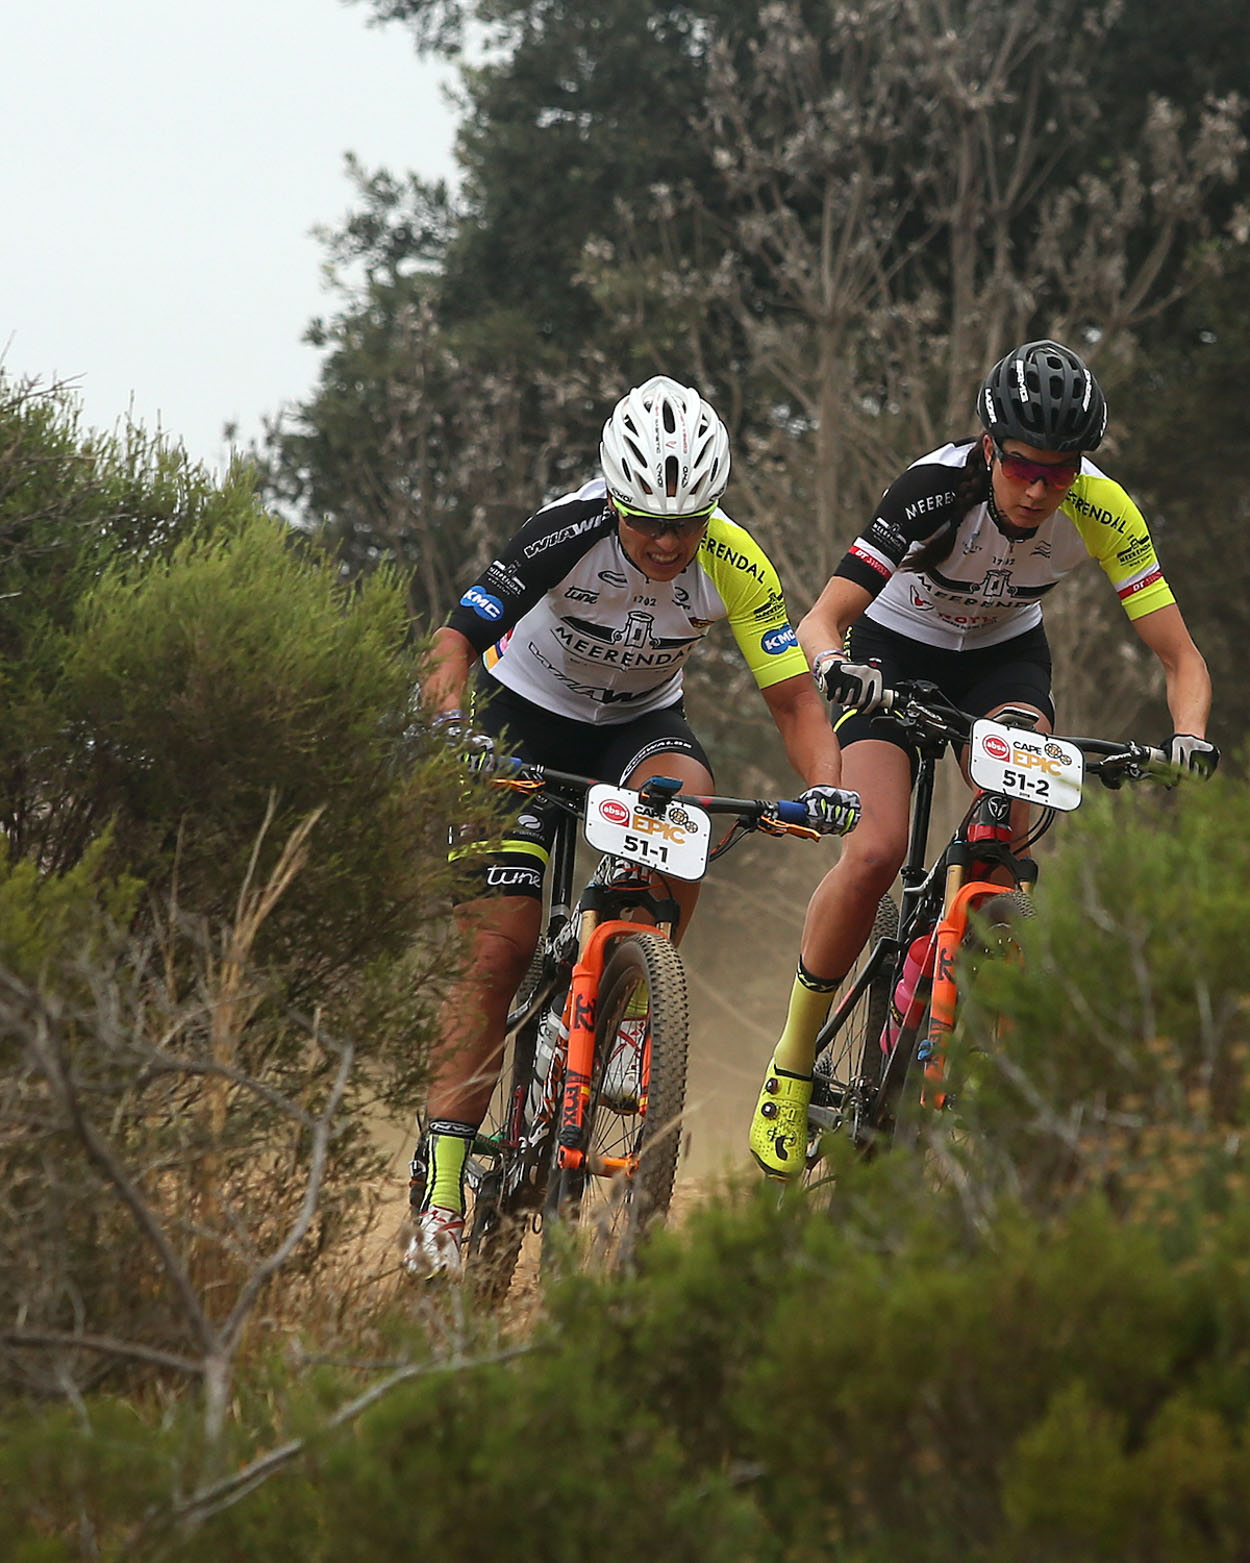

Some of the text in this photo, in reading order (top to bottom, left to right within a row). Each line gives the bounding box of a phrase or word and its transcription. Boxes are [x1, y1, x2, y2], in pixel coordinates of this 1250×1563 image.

[462, 589, 501, 619] KMC
[1013, 741, 1042, 756] CAPE
[1013, 749, 1062, 776] EPIC
[1002, 769, 1050, 797] 51-2
[603, 804, 626, 817] absa
[632, 813, 686, 845] EPIC
[623, 834, 668, 863] 51-1
[487, 866, 541, 888] tune
